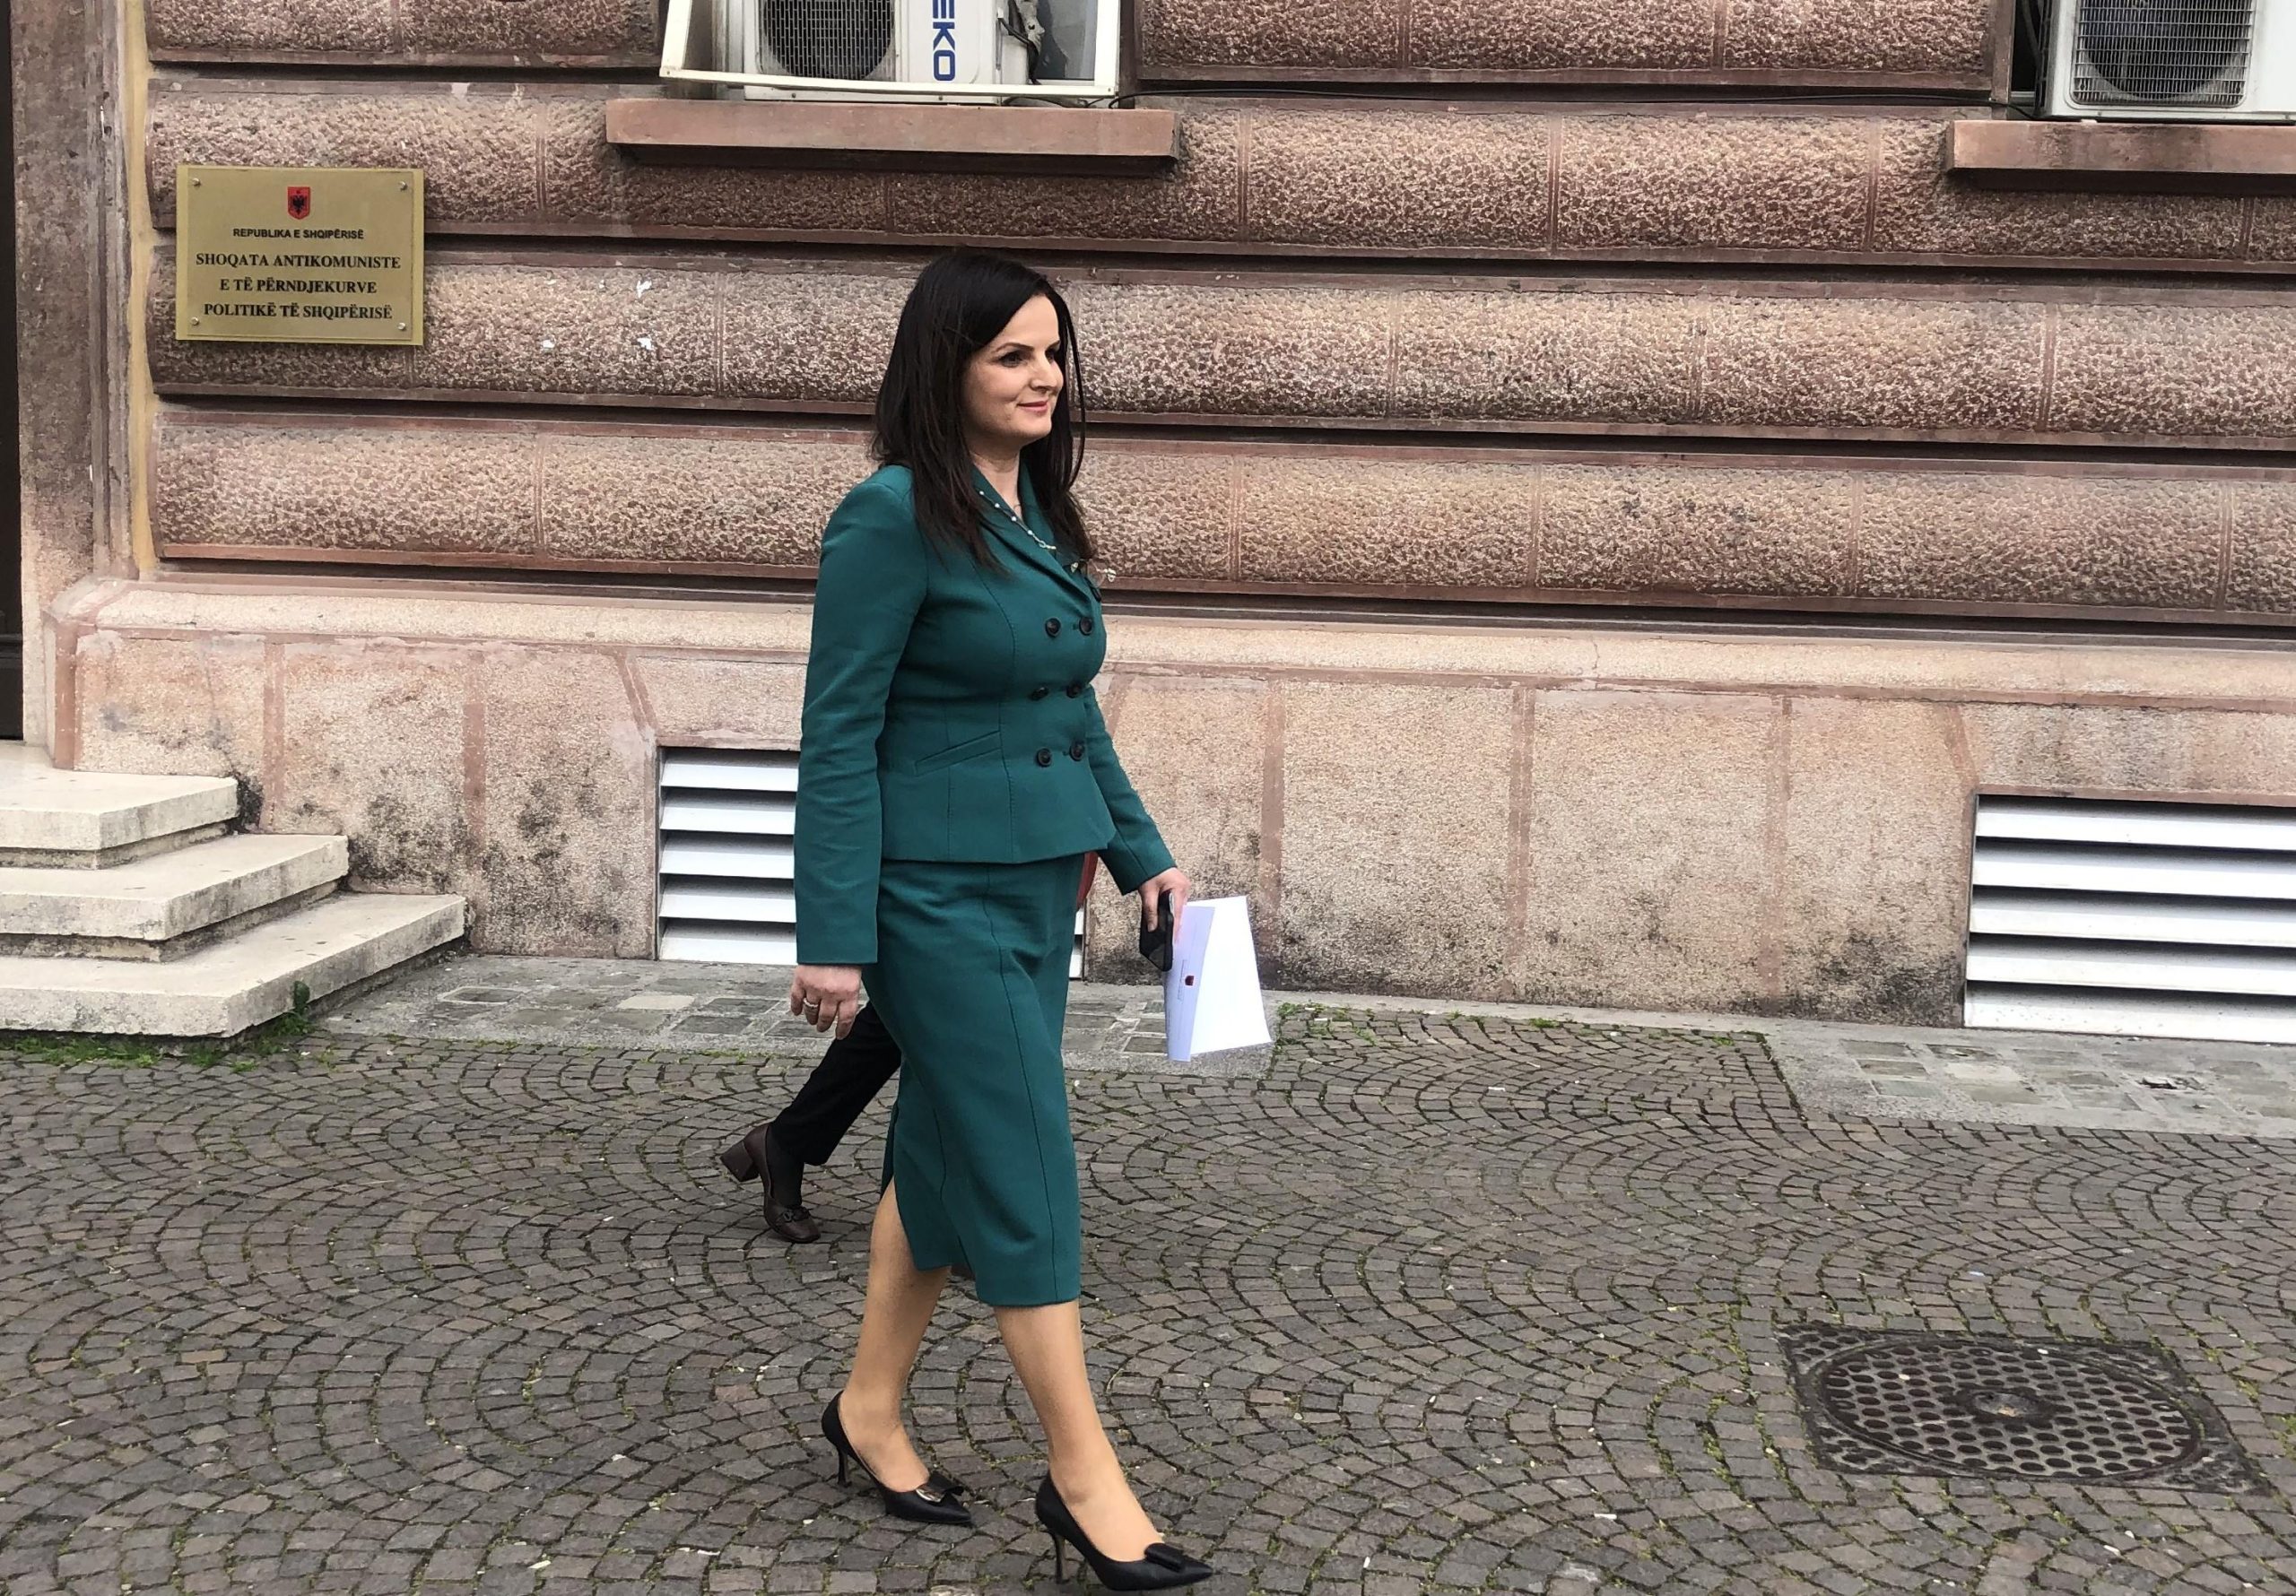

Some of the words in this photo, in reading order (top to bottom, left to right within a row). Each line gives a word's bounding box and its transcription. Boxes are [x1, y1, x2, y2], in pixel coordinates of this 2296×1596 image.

[233, 228, 291, 239] REPUBLIKA
[293, 229, 300, 239] E
[303, 228, 364, 239] SHQIPËRISË
[196, 253, 269, 268] SHOQATA
[273, 255, 401, 269] ANTIKOMUNISTE
[220, 278, 230, 291] E
[233, 276, 253, 291] TË
[257, 277, 377, 293] PËRNDJEKURVE
[204, 302, 276, 317] POLITIKË
[280, 302, 300, 317] TË
[303, 304, 393, 320] SHQIPËRISË
